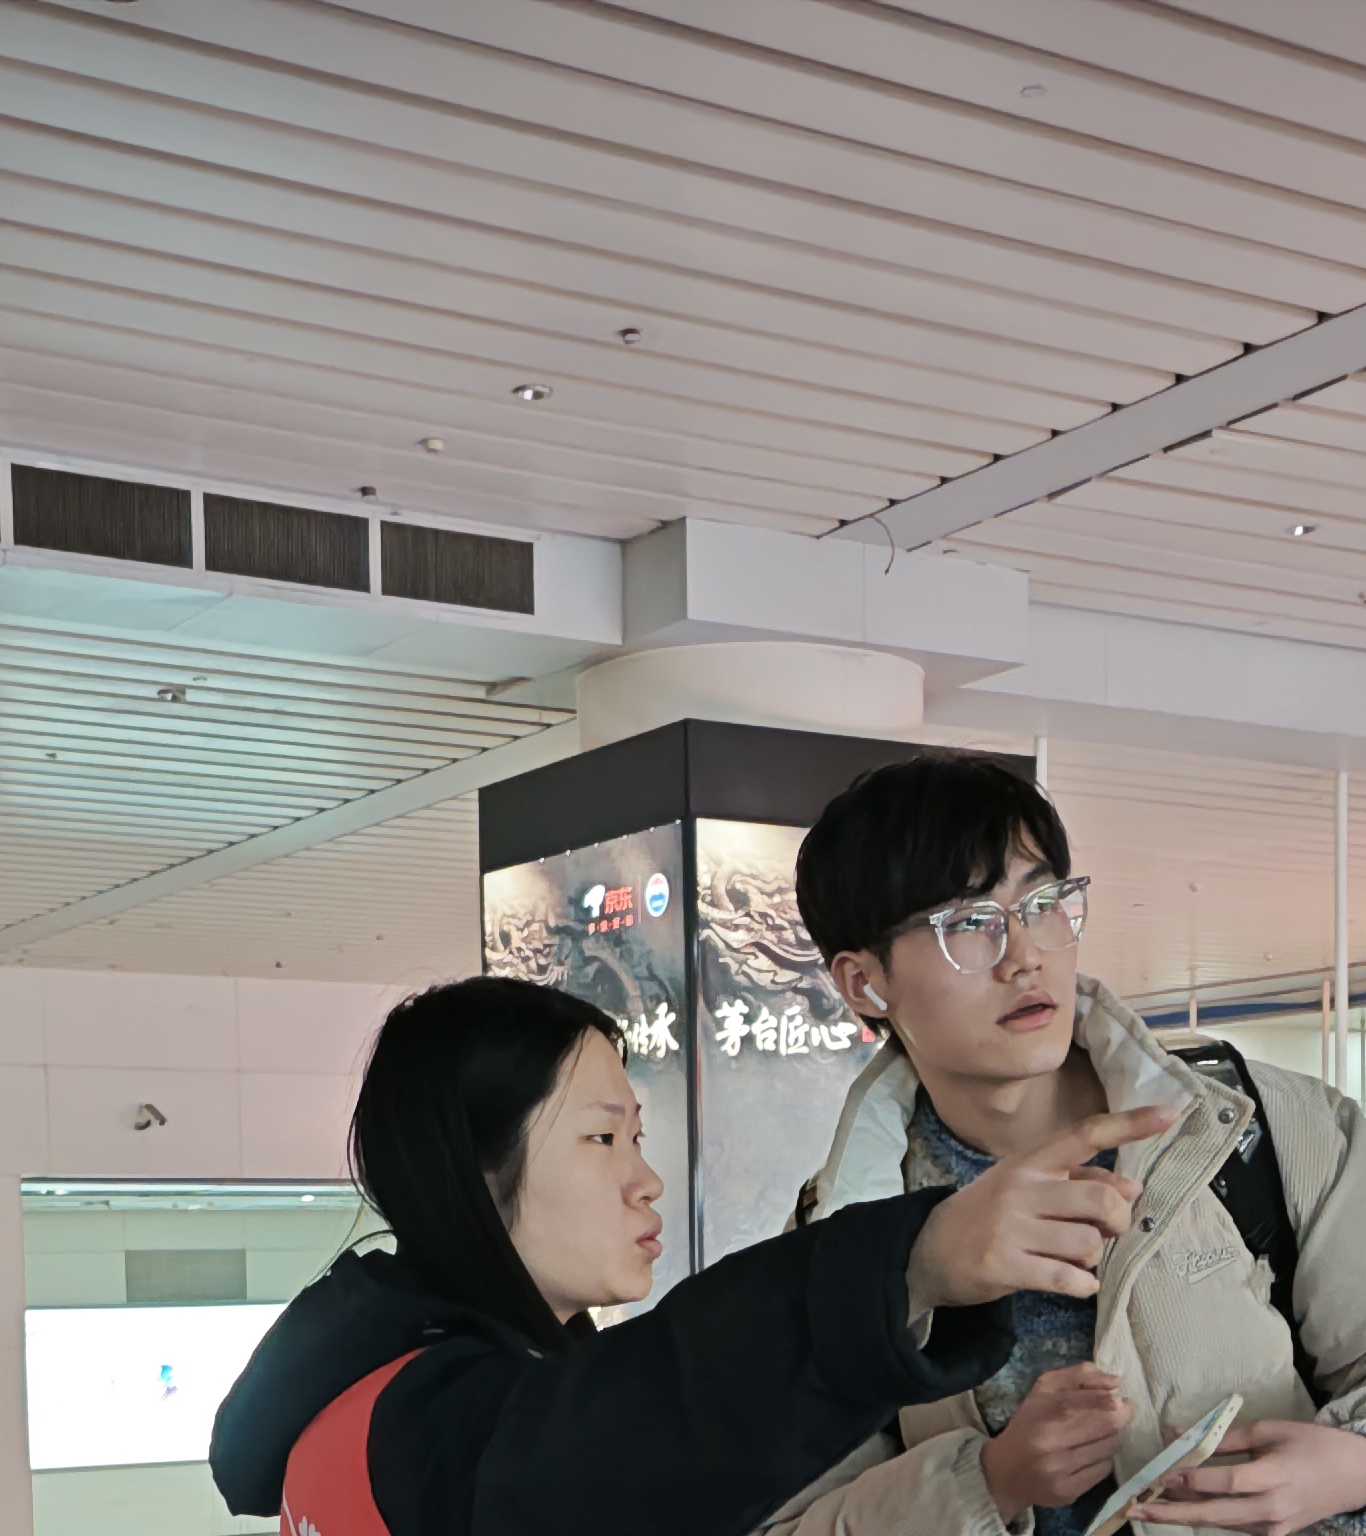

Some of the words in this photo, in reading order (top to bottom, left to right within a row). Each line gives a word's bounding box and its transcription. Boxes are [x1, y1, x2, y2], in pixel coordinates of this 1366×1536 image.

[616, 1002, 680, 1059] 传承
[715, 999, 857, 1056] 茅台匠心
